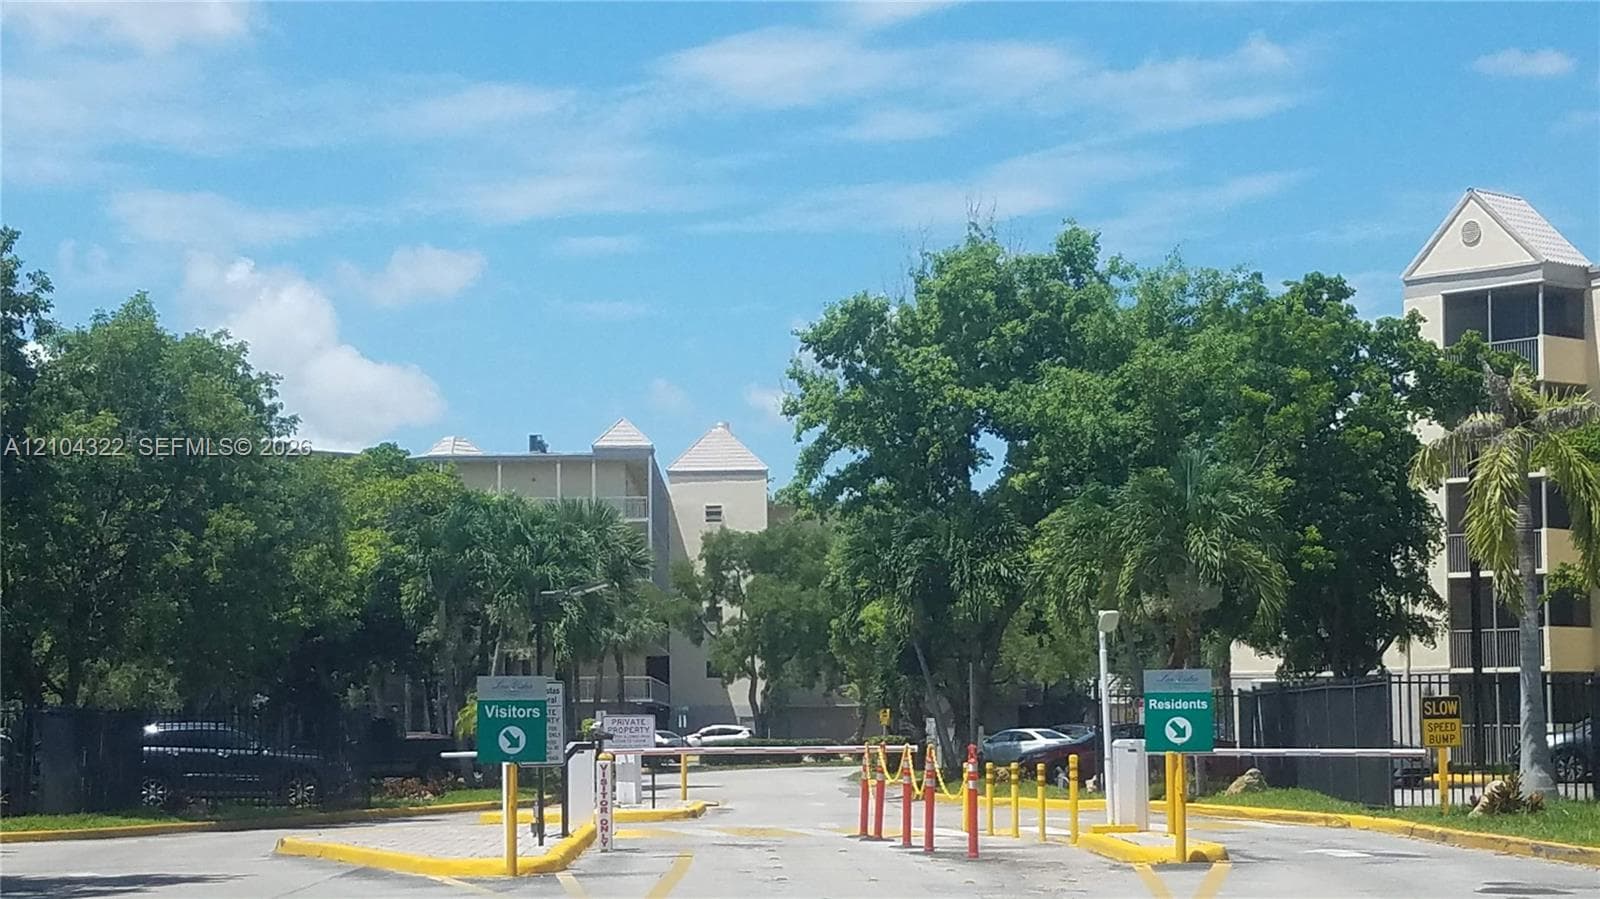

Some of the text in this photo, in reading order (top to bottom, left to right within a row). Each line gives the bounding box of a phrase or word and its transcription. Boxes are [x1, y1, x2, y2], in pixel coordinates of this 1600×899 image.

[1148, 698, 1208, 710] Residents
[1423, 700, 1458, 716] SLOW
[484, 704, 541, 718] Visitors
[611, 718, 646, 726] PRIVATE
[1427, 722, 1457, 733] SPEED
[607, 726, 650, 734] PROPERTY
[1429, 734, 1456, 744] BUMP
[599, 764, 609, 847] VISITOR ONLY
